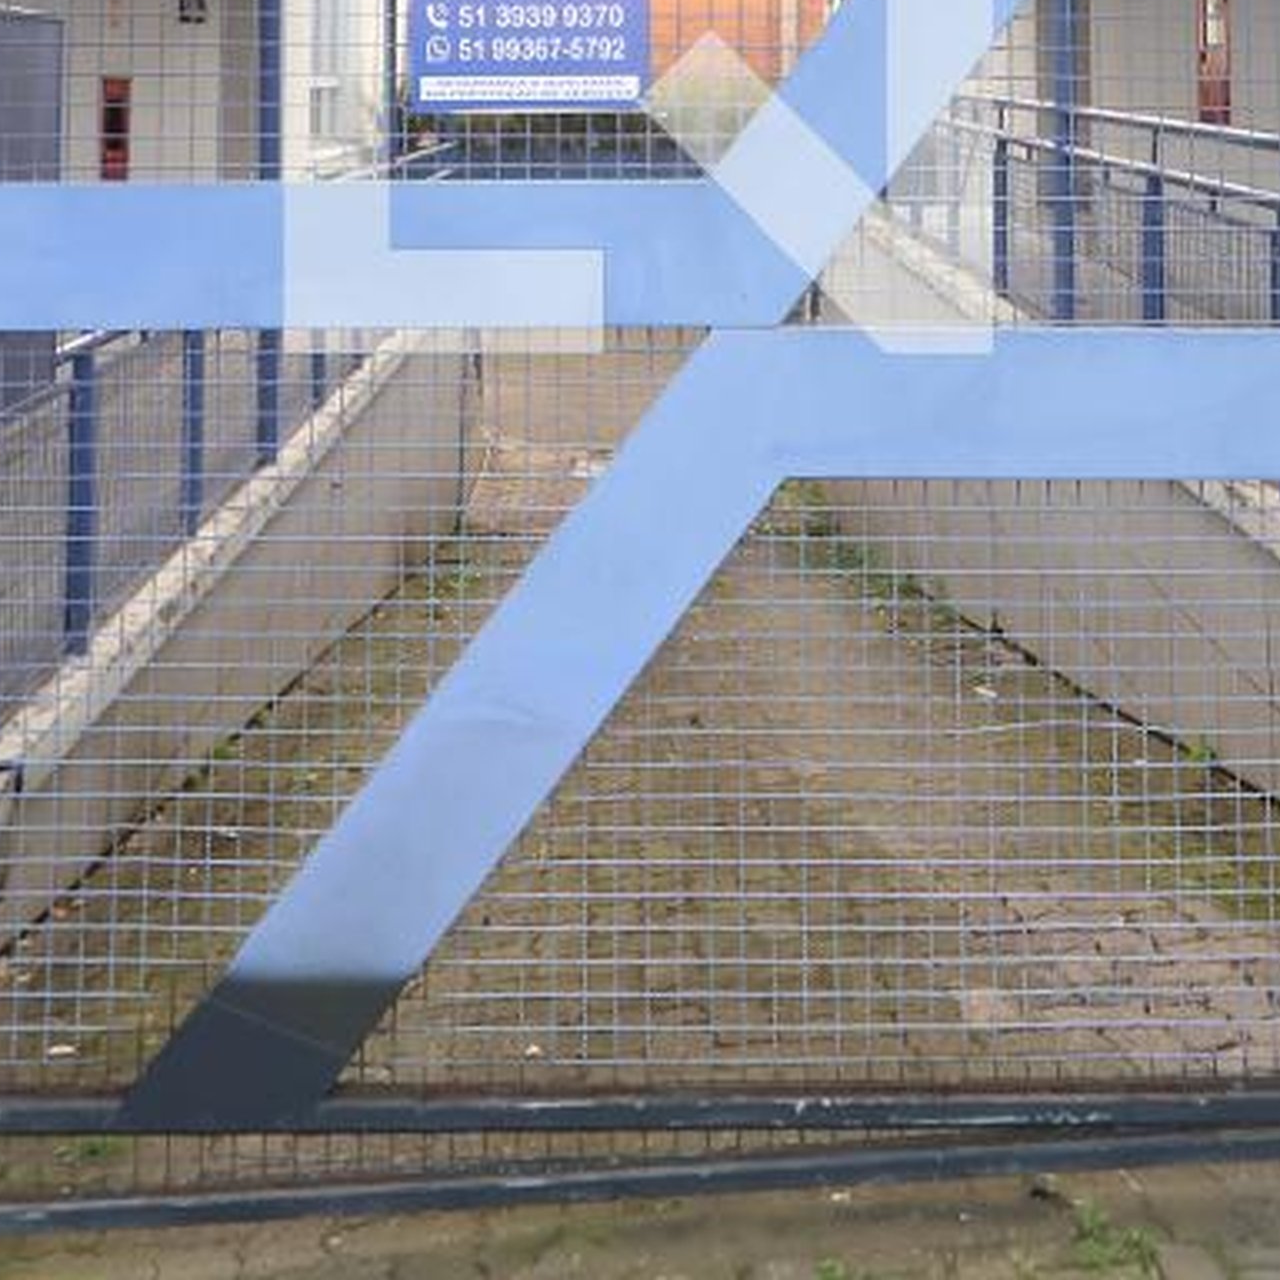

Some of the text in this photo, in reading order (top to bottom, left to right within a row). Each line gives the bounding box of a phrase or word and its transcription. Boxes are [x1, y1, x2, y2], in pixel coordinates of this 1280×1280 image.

[458, 4, 625, 28] 51 3939 9370
[458, 36, 626, 61] 51 99367-5792
